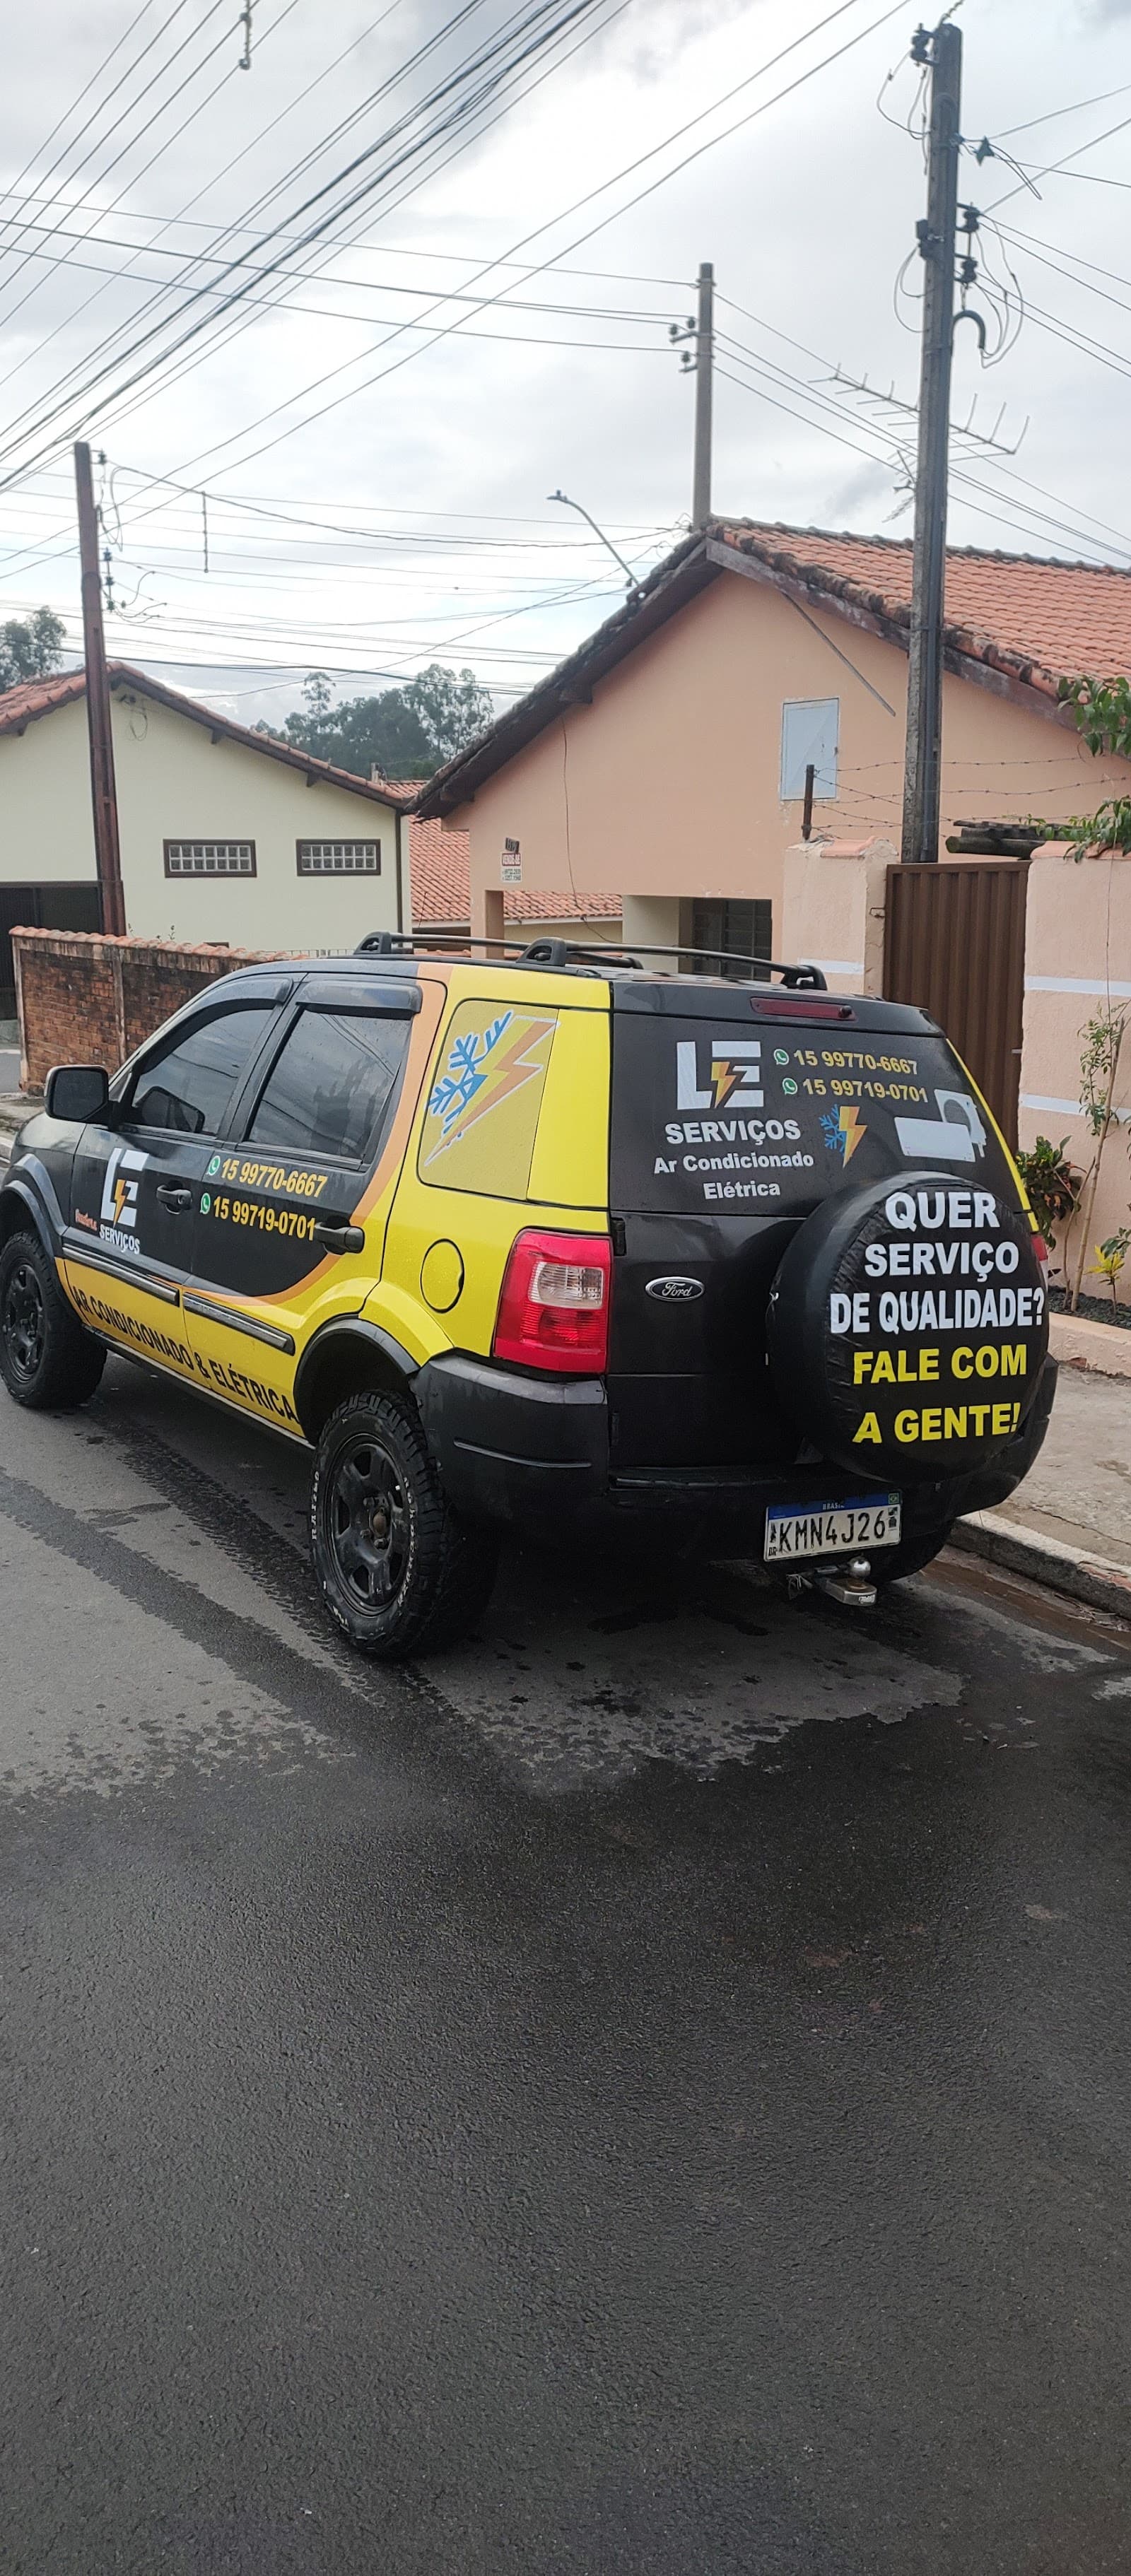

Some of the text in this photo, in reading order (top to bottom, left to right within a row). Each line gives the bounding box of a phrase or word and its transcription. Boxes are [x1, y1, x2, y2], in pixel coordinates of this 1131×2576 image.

[793, 1049, 918, 1075] 15 99770-6667
[802, 1078, 929, 1103] 15 99719-0701
[665, 1119, 802, 1146] SERVIÇOS
[222, 1158, 329, 1198] 15 99770-6667
[654, 1151, 814, 1175] Ar Condicionado
[703, 1180, 781, 1200] Elétrica
[213, 1196, 316, 1242] 15 99719-0701
[885, 1192, 1000, 1232] QUER
[100, 1223, 141, 1255] SERVIÇOS
[865, 1241, 1019, 1283] SERVIÇO
[662, 1282, 693, 1297] Ford
[830, 1287, 1045, 1335] DE QUALIDADE?
[73, 1285, 300, 1425] AR CONDICIONADO & ELÉTRICA
[852, 1343, 1027, 1384] FALE COM
[852, 1401, 1021, 1443] A GENTE!
[779, 1510, 886, 1552] KMN4J26
